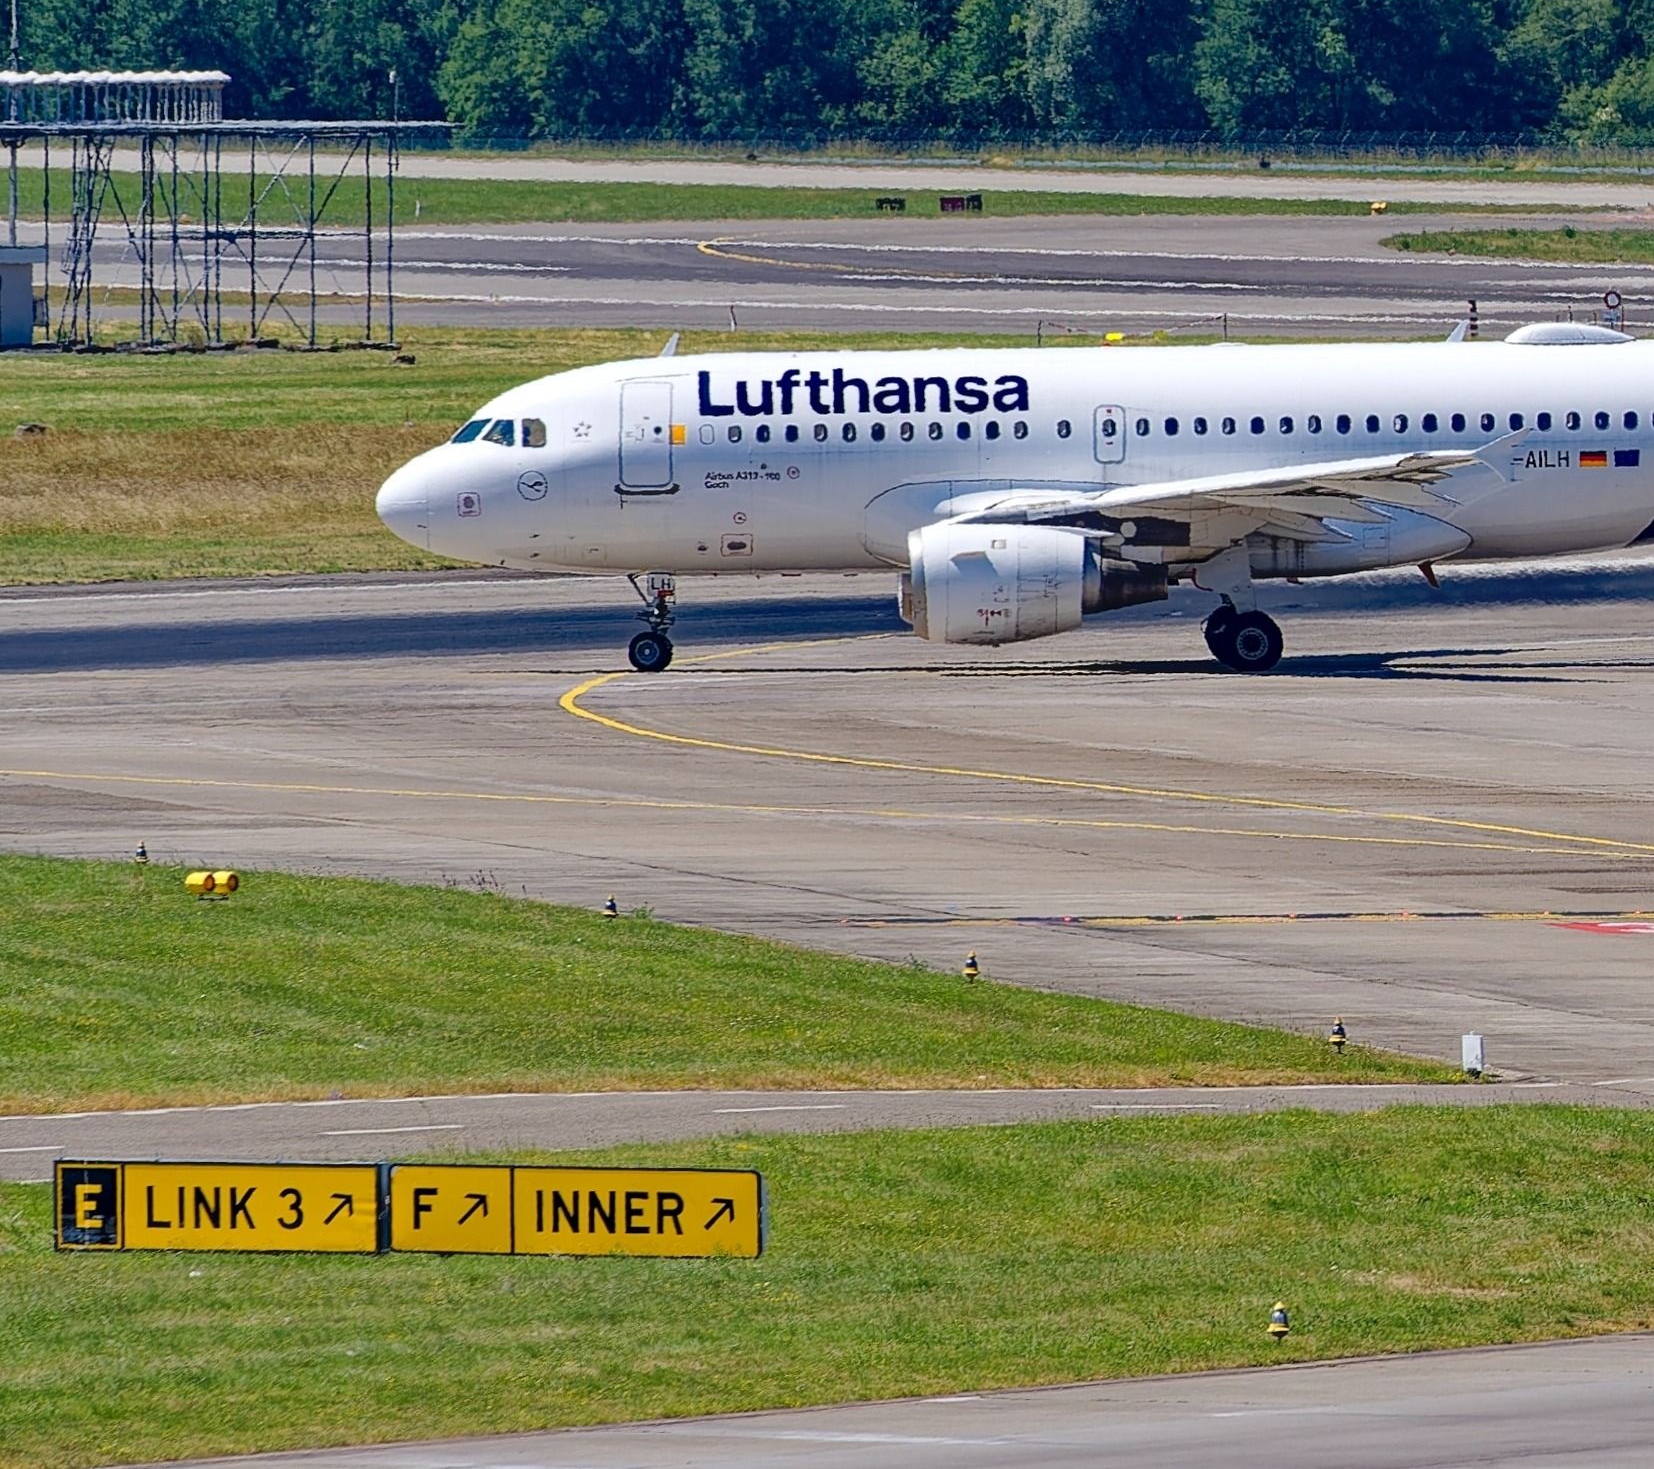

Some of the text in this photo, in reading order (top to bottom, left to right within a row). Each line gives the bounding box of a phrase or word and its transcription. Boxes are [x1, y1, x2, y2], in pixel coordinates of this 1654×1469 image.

[698, 368, 1030, 416] Lufthansa
[651, 577, 671, 590] LH
[75, 1183, 684, 1235] E LINK 3 F INNER
